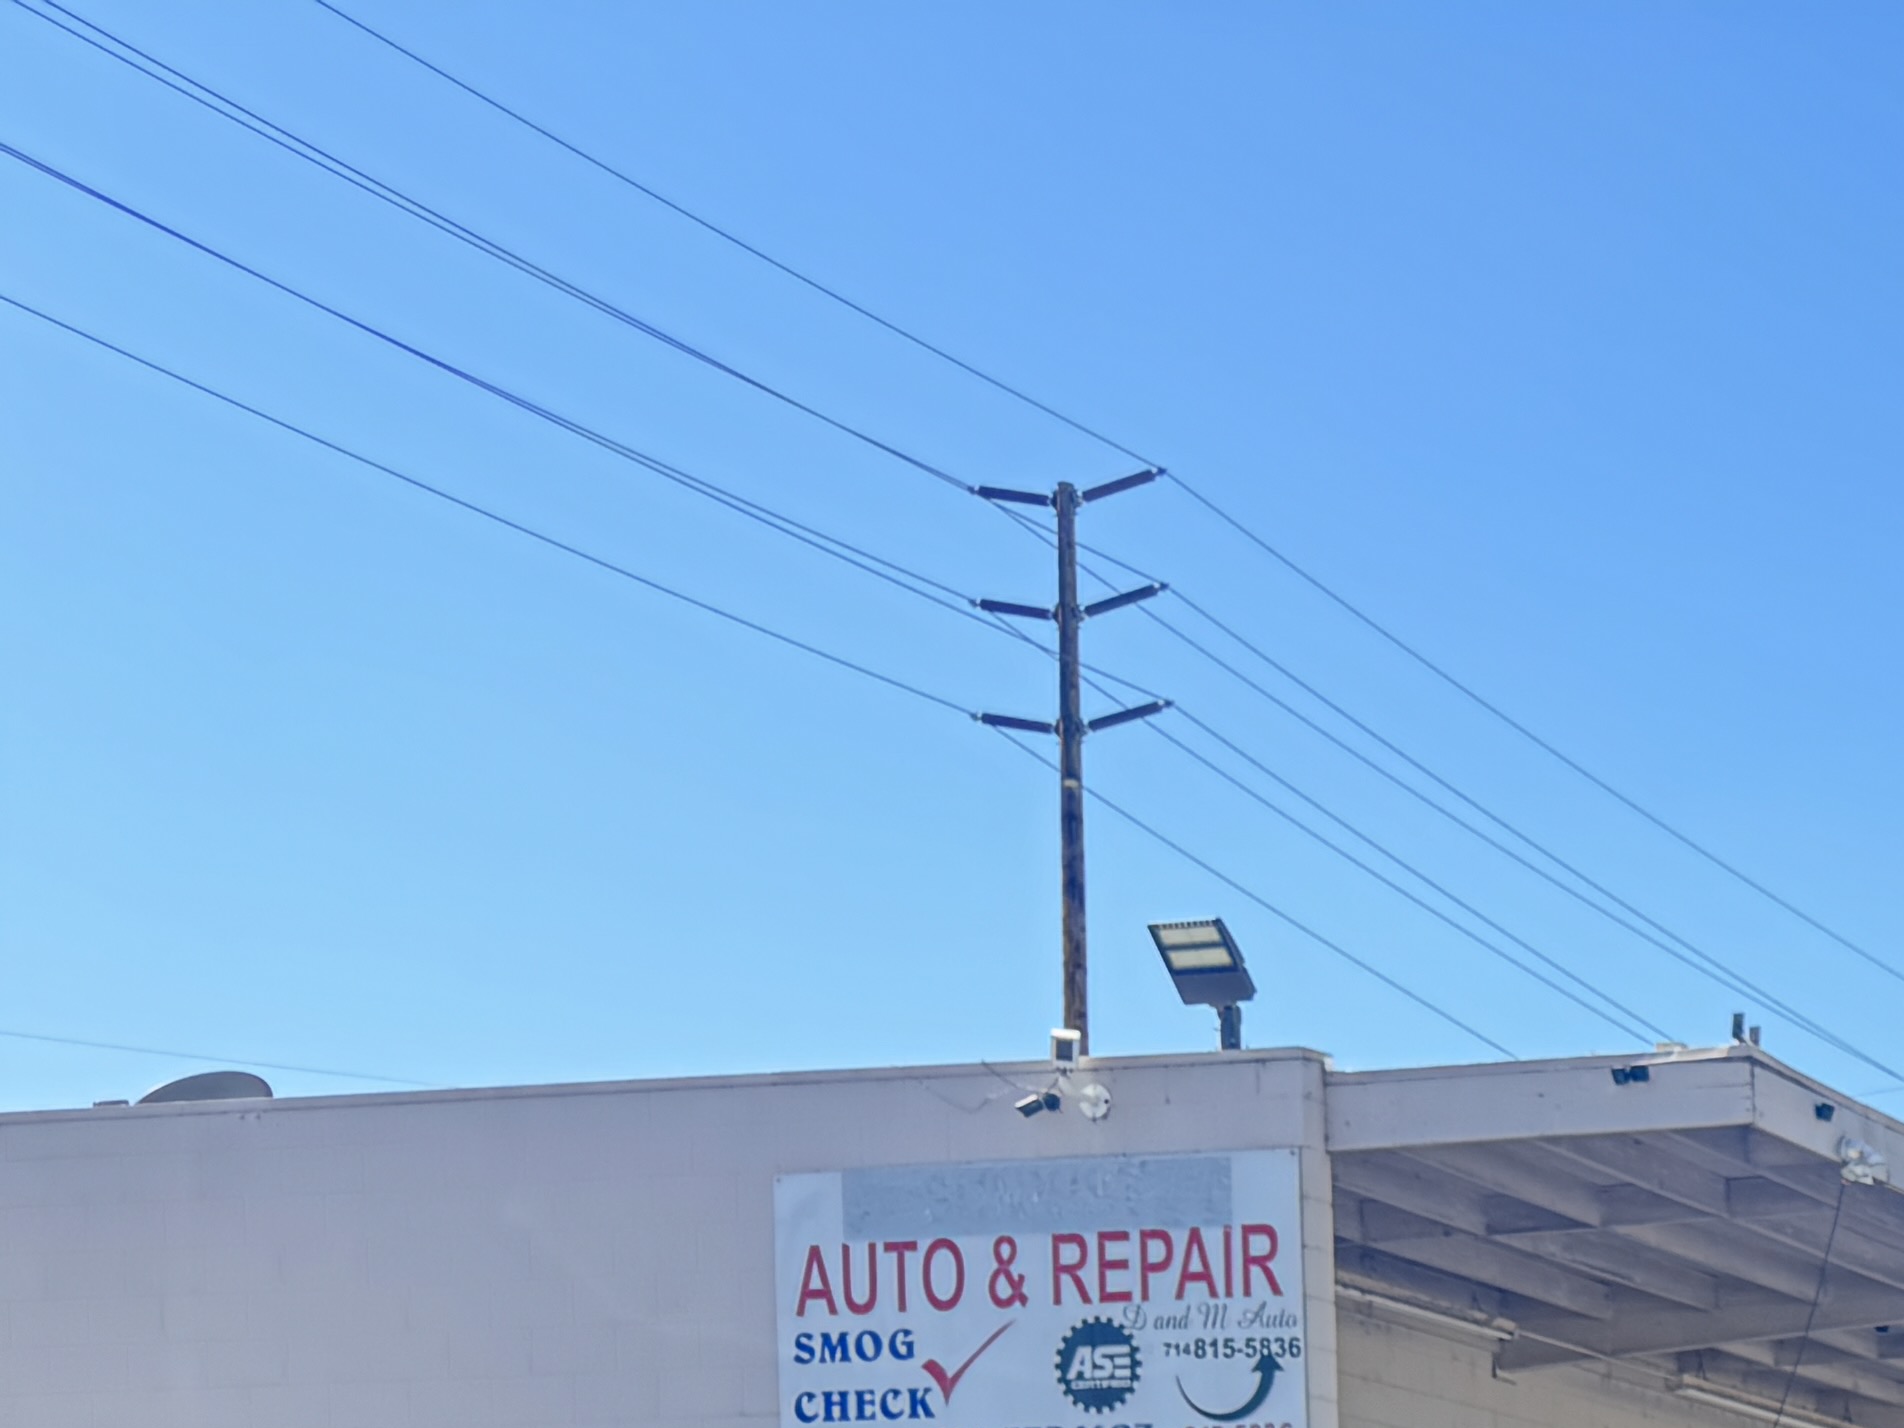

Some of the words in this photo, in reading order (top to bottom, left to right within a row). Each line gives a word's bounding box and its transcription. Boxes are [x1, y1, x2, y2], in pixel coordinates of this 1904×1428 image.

[796, 1237, 965, 1317] AUTO
[988, 1235, 1029, 1309] &
[1052, 1223, 1283, 1306] REPAIR
[1153, 1304, 1191, 1330] and
[1197, 1302, 1228, 1330] M
[1237, 1301, 1298, 1330] Auto
[793, 1329, 916, 1365] SMOG
[1066, 1344, 1132, 1380] ASE
[793, 1388, 935, 1423] CHECK
